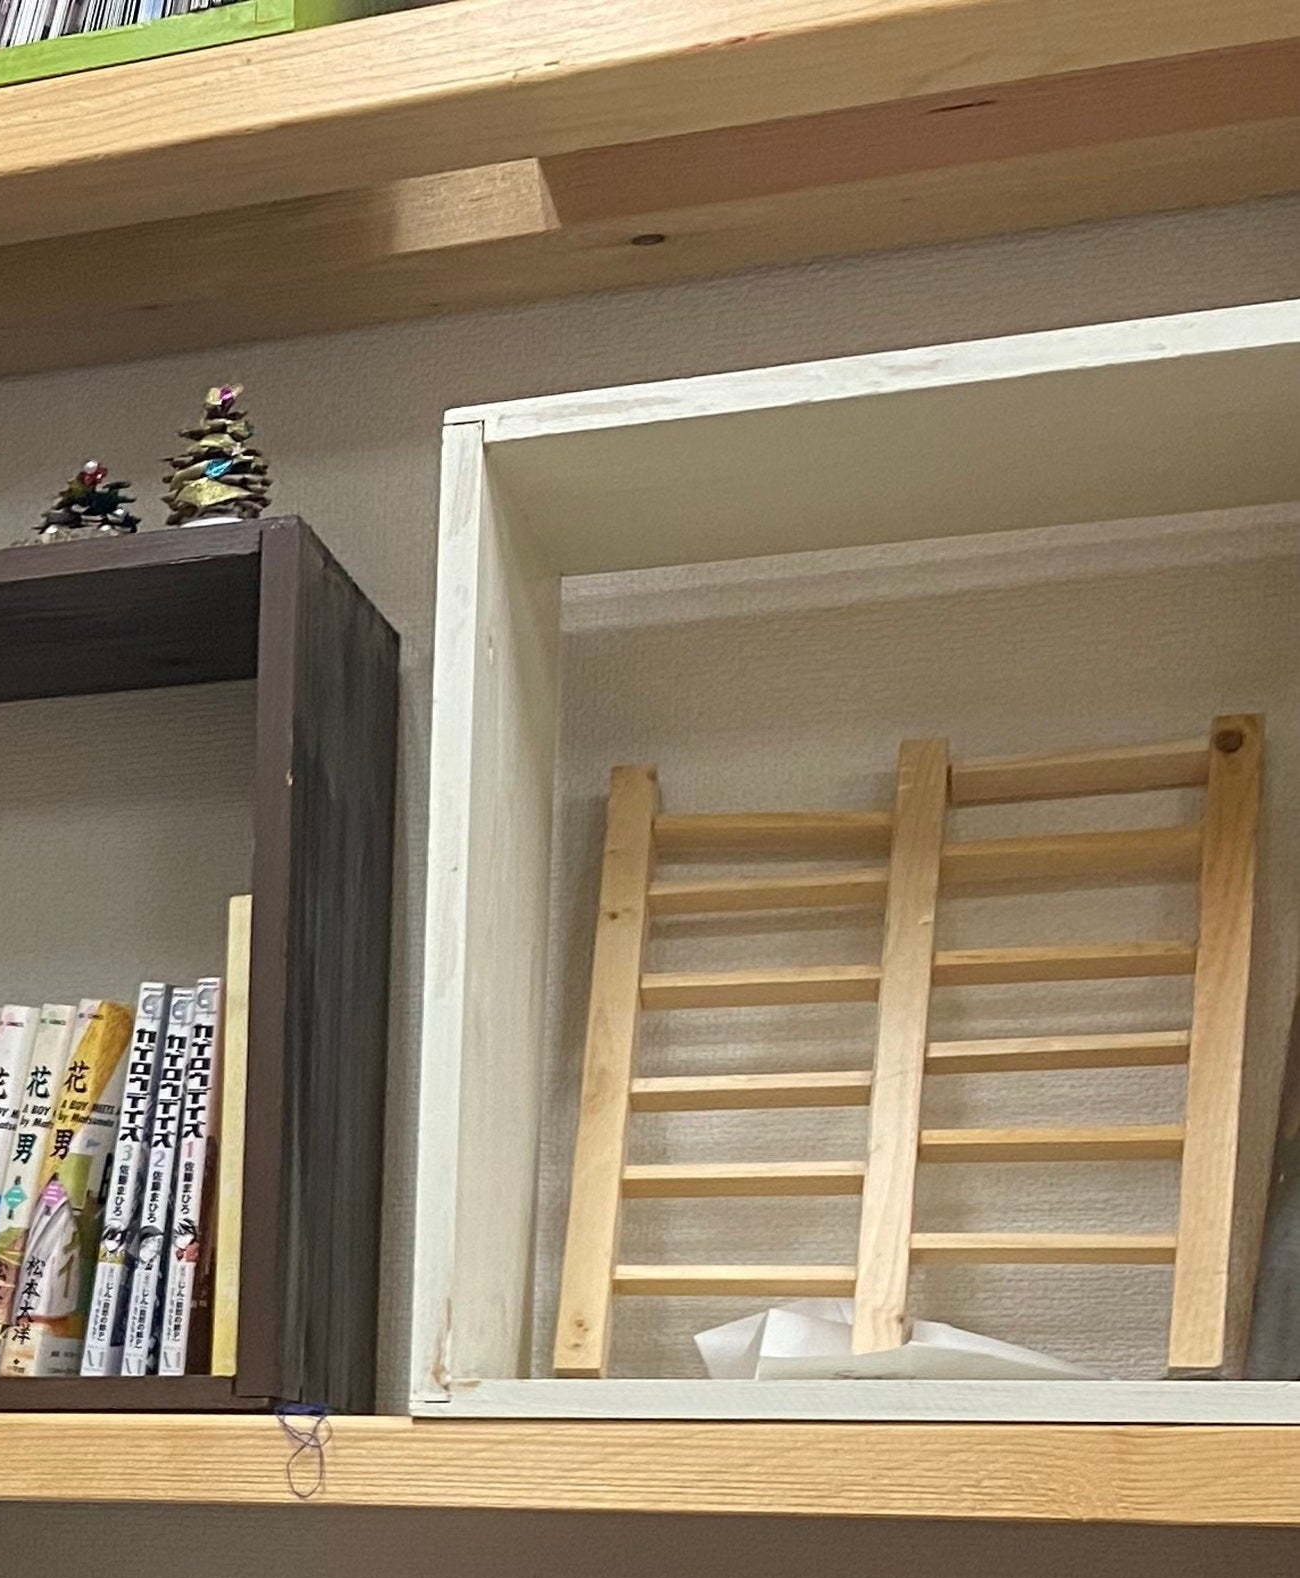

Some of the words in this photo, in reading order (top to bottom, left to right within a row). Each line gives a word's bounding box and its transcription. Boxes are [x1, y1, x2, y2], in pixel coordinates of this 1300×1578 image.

[26, 1065, 52, 1099] 花
[64, 1060, 91, 1094] 花
[119, 1027, 157, 1142] カゲロウデイズ
[152, 1034, 188, 1149] カゲロウデイズ
[182, 1023, 214, 1138] カゲロウデイズ
[13, 1132, 38, 1164] 男
[50, 1129, 75, 1160] 男
[121, 1144, 133, 1162] 3
[153, 1151, 165, 1168] 2
[186, 1142, 194, 1158] 1
[13, 1256, 47, 1345] 松本大洋
